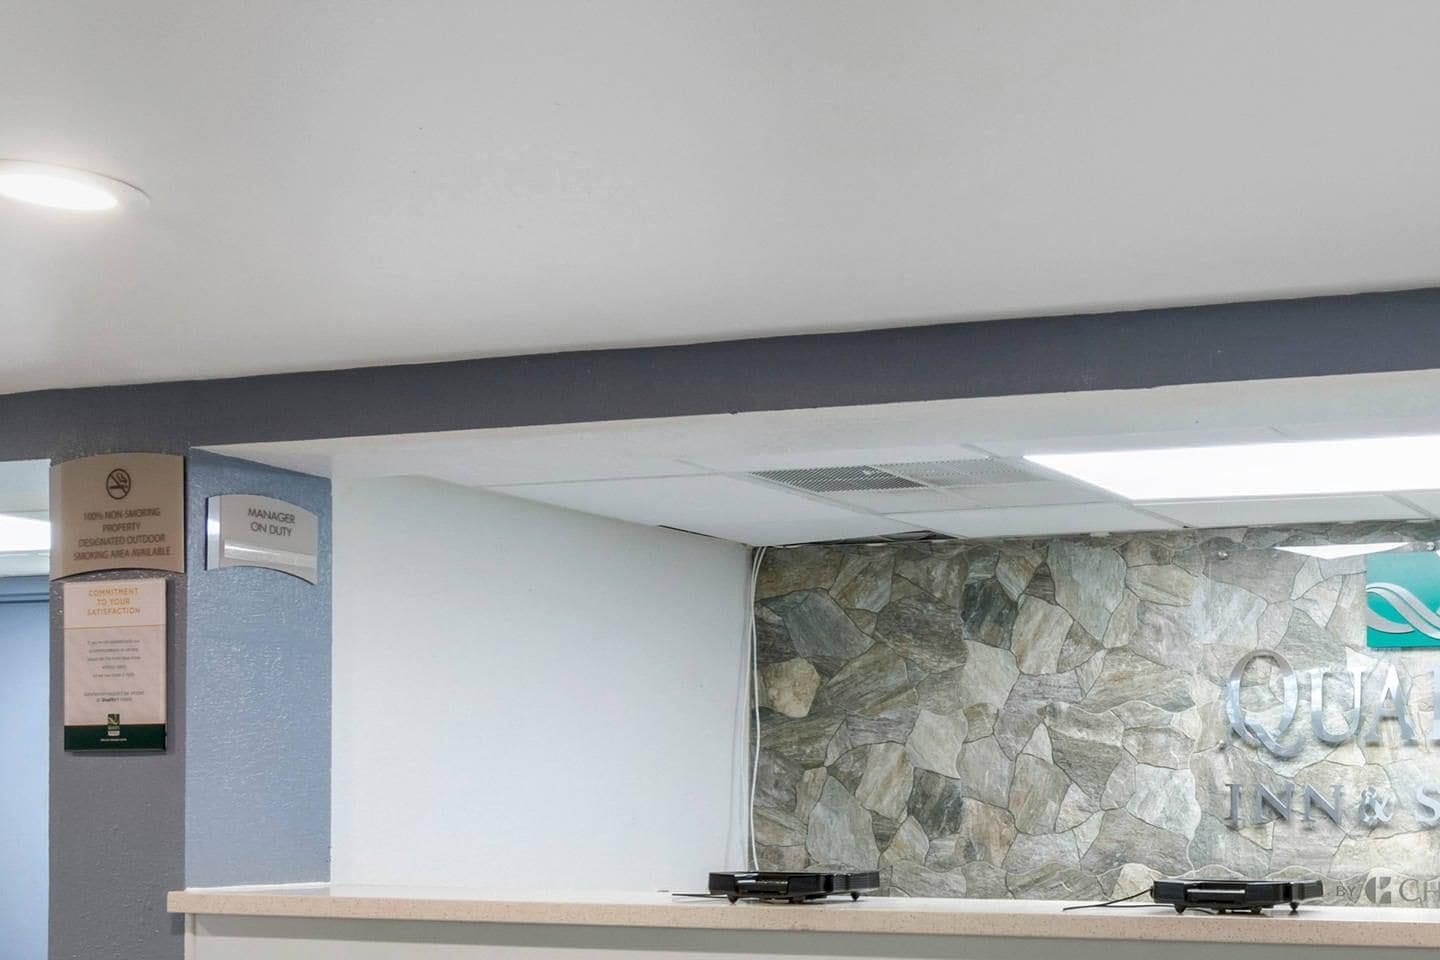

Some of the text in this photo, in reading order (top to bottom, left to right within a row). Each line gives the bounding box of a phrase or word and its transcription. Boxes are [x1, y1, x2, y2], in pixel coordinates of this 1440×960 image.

[247, 508, 296, 524] MANAGER
[103, 522, 141, 533] PROPERTY
[250, 521, 293, 536] ON DUTY
[79, 534, 165, 548] DESIGNATED OUTDOOR
[73, 546, 171, 560] SMOKING AREA AVAILABLE
[88, 587, 139, 597] COMMITMENT
[87, 607, 141, 616] SATISFACTION
[1224, 783, 1344, 825] INN
[1358, 786, 1394, 824] &
[1336, 885, 1356, 897] BY
